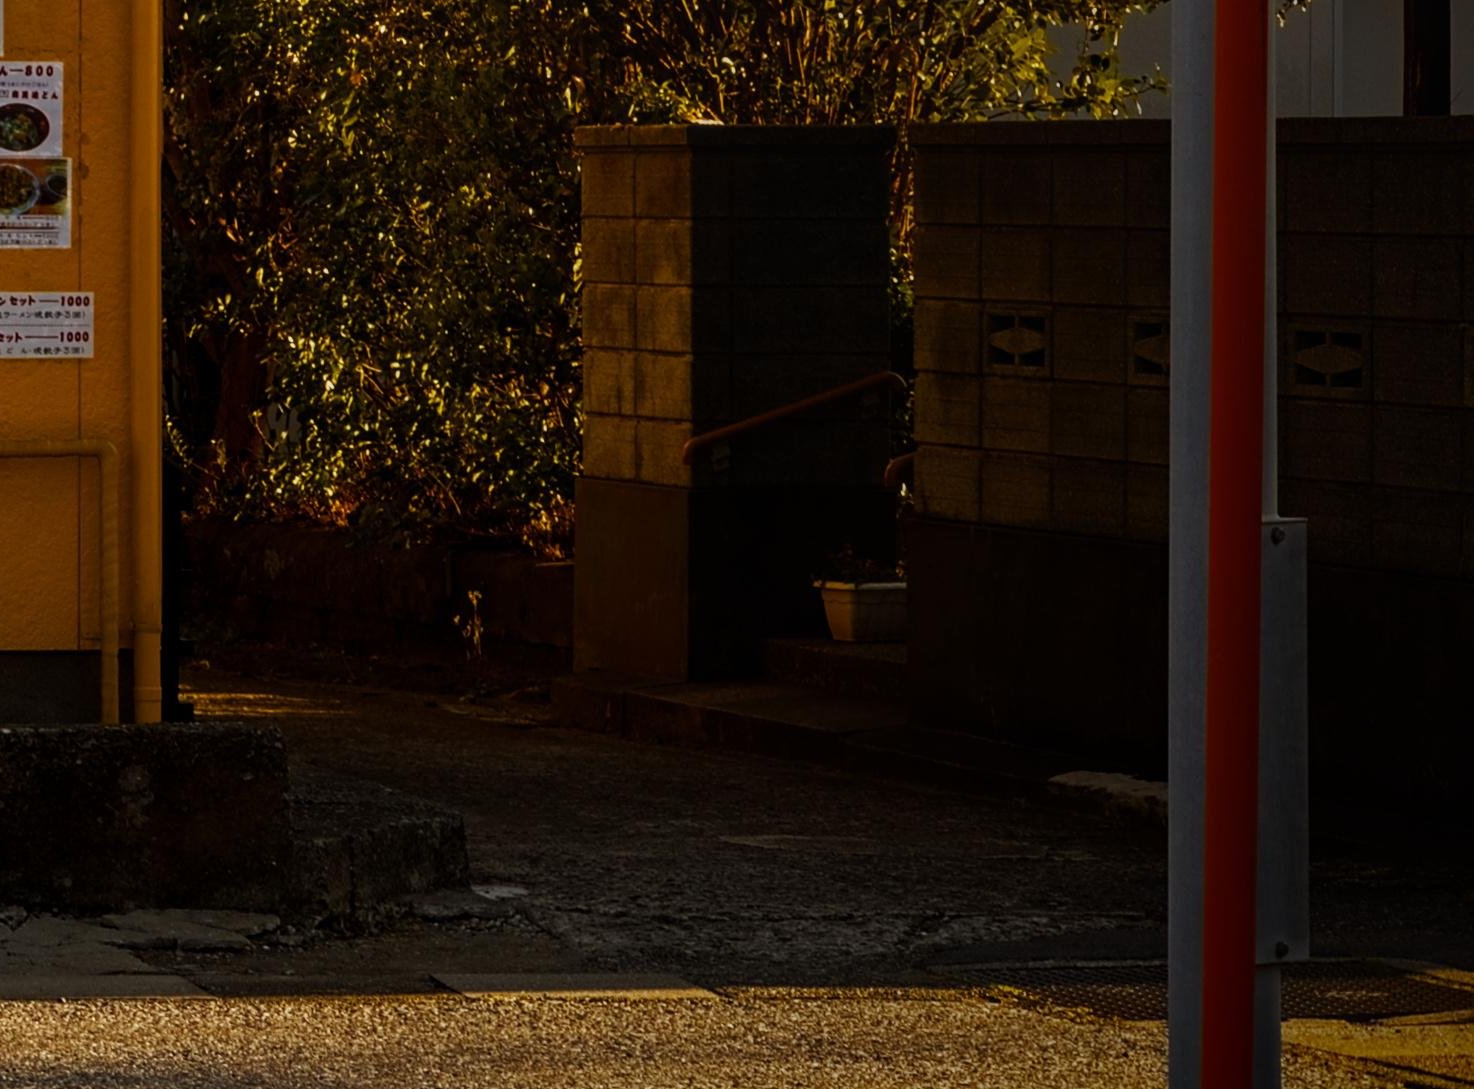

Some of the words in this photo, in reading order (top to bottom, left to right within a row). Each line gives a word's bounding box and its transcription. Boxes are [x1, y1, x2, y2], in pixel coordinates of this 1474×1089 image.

[25, 64, 54, 76] 800
[60, 295, 90, 307] 1000
[59, 331, 90, 343] 1000
